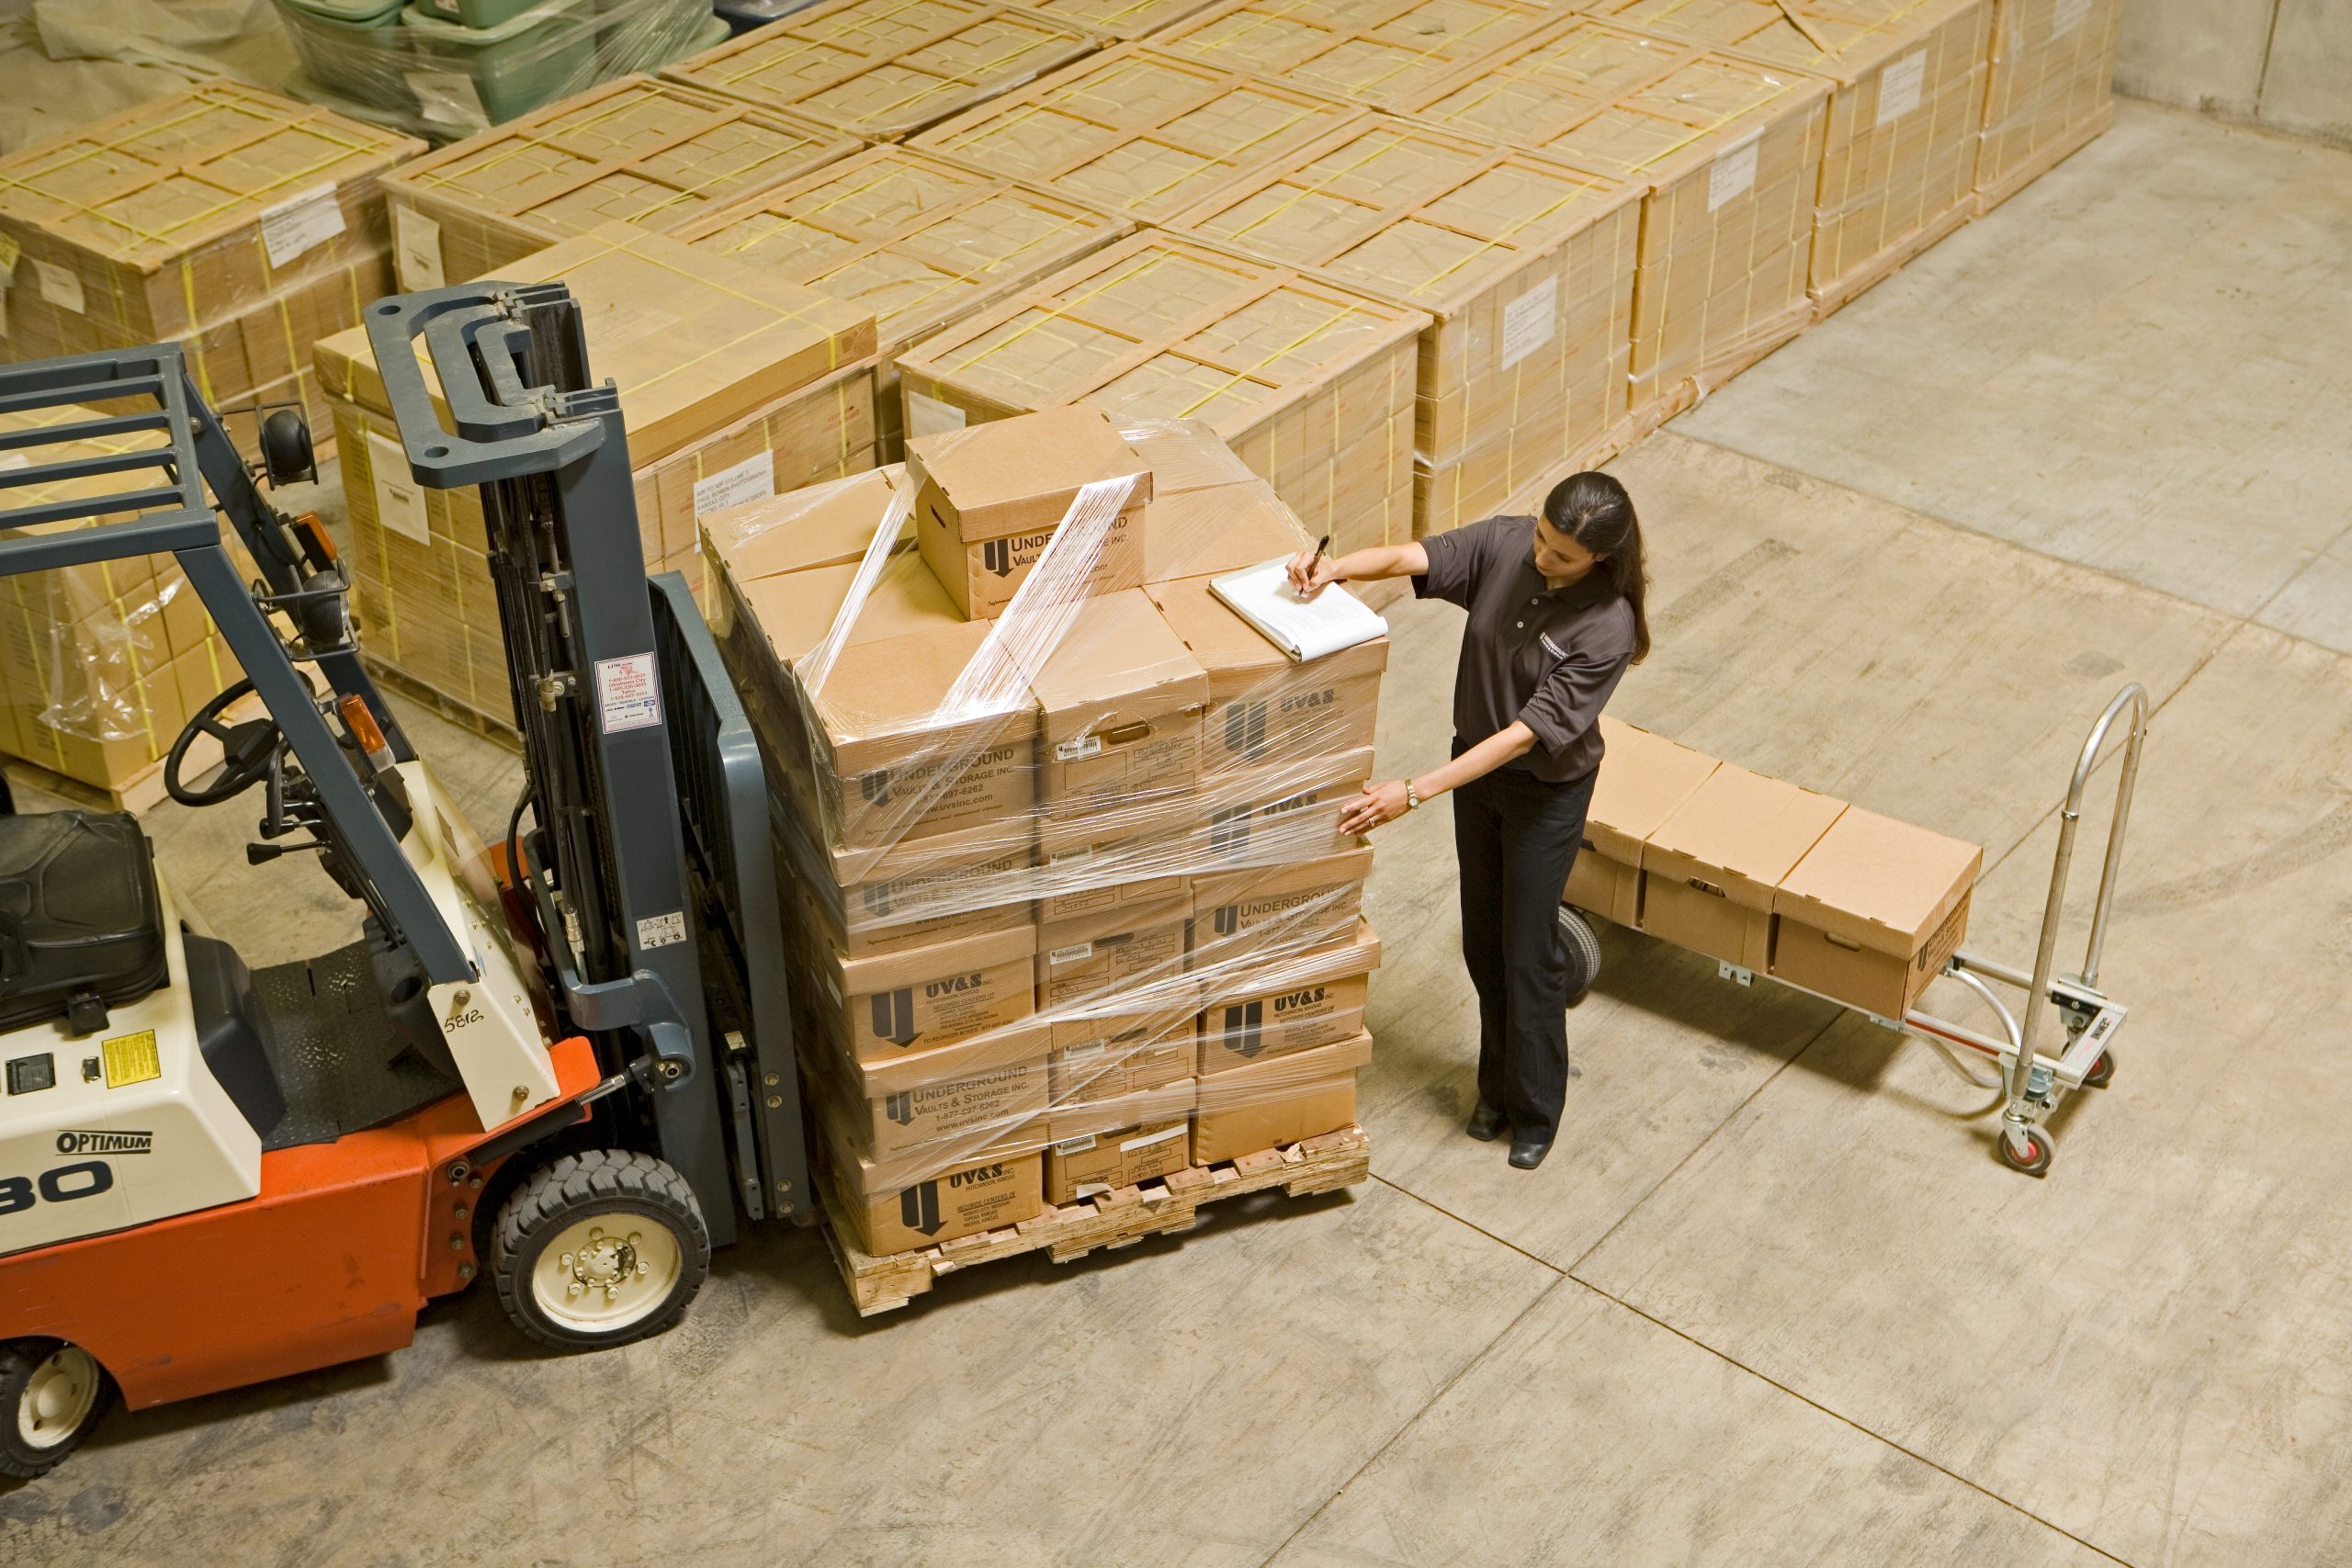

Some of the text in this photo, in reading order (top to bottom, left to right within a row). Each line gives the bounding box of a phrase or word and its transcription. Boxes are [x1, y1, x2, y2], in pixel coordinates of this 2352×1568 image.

[1012, 516, 1128, 552] UNDEND
[1012, 554, 1041, 567] VAULT
[1240, 889, 1339, 918] UNDERGRO
[925, 973, 982, 998] UV&S
[1274, 987, 1325, 1011] UV&S
[444, 1009, 484, 1033] 5812
[912, 1066, 1027, 1103] UNDERGROUND
[914, 1081, 1030, 1116] VAULTS & STORAGE INC.
[56, 1132, 153, 1154] OPTIMUM
[950, 1163, 1003, 1188] UV&S
[997, 1173, 1015, 1183] KANSAS
